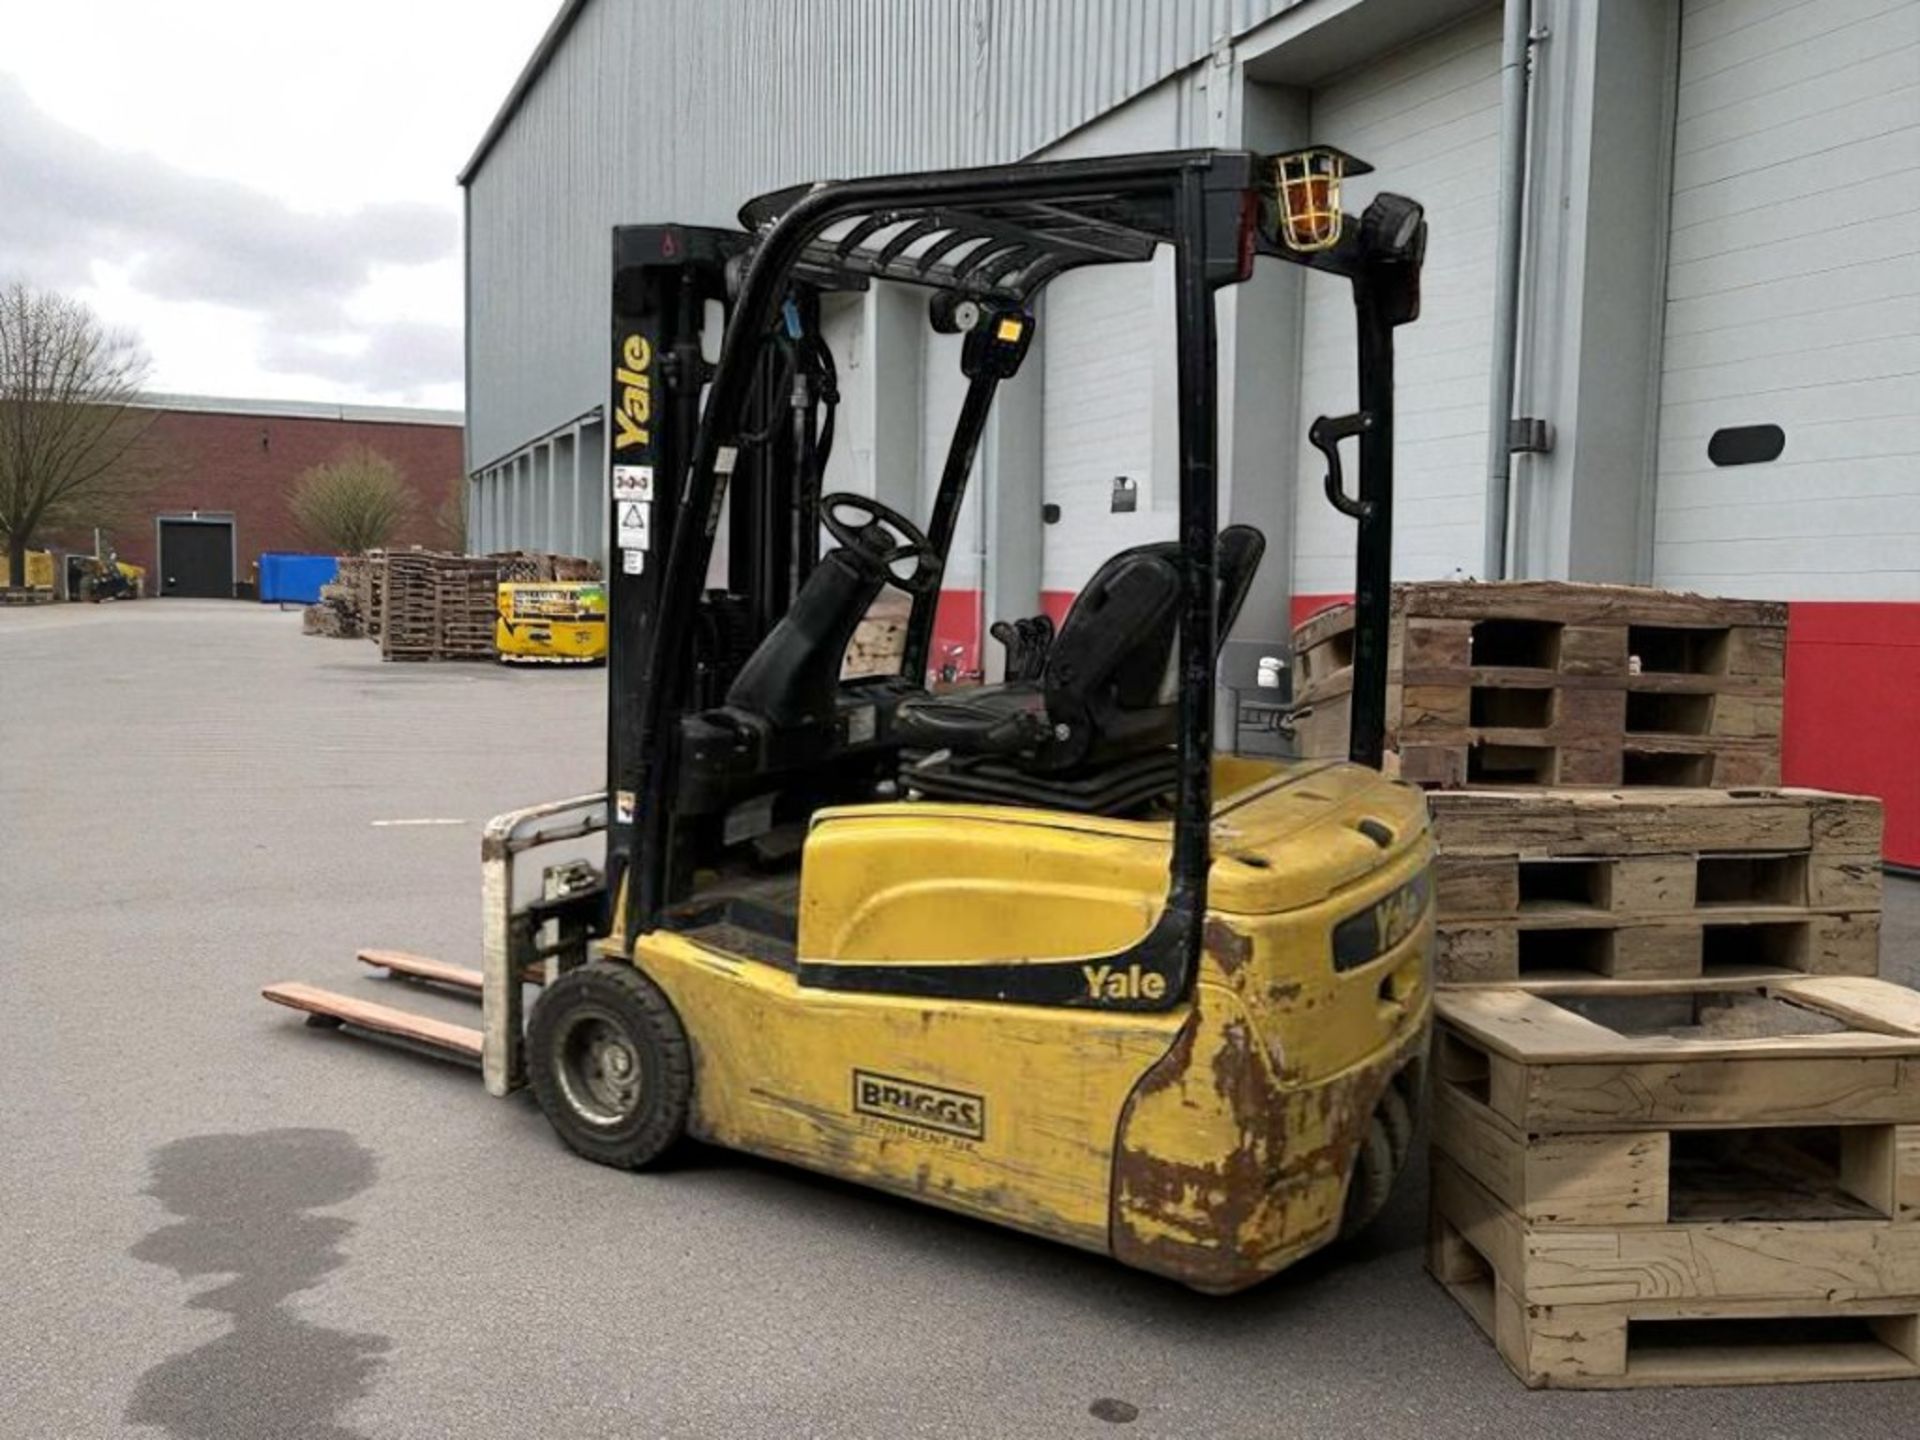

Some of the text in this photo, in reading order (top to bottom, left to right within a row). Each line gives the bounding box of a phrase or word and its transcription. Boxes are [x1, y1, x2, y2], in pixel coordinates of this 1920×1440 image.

[615, 334, 650, 449] Yale
[1082, 964, 1166, 999] Yale
[862, 1081, 979, 1130] BRIGGS
